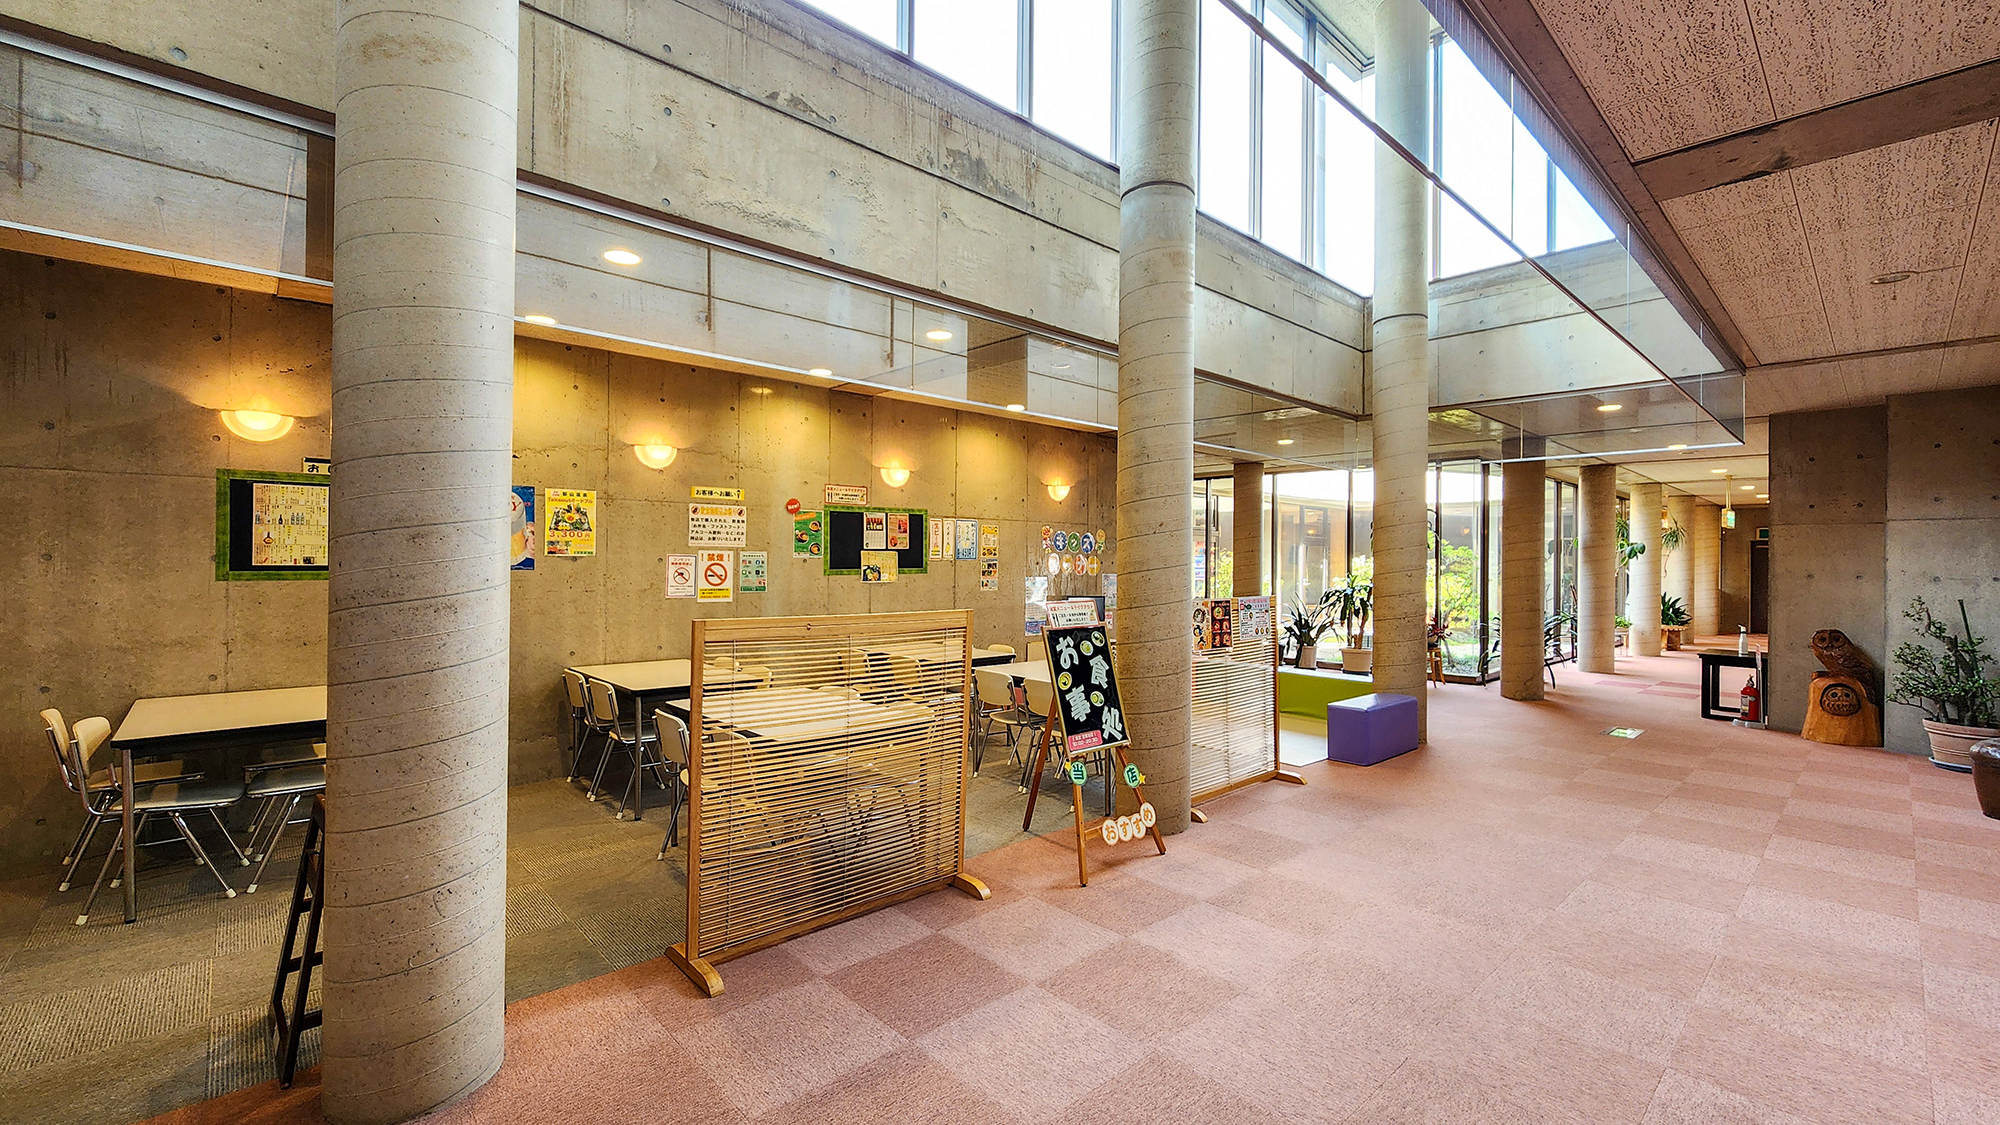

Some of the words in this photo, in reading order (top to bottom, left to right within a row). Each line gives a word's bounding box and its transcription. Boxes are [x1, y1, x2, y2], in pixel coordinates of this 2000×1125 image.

[695, 489, 737, 498] お客様へお願い
[787, 502, 800, 510] New!
[549, 530, 591, 538] 3,300円
[1105, 807, 1153, 841] おすすめ
